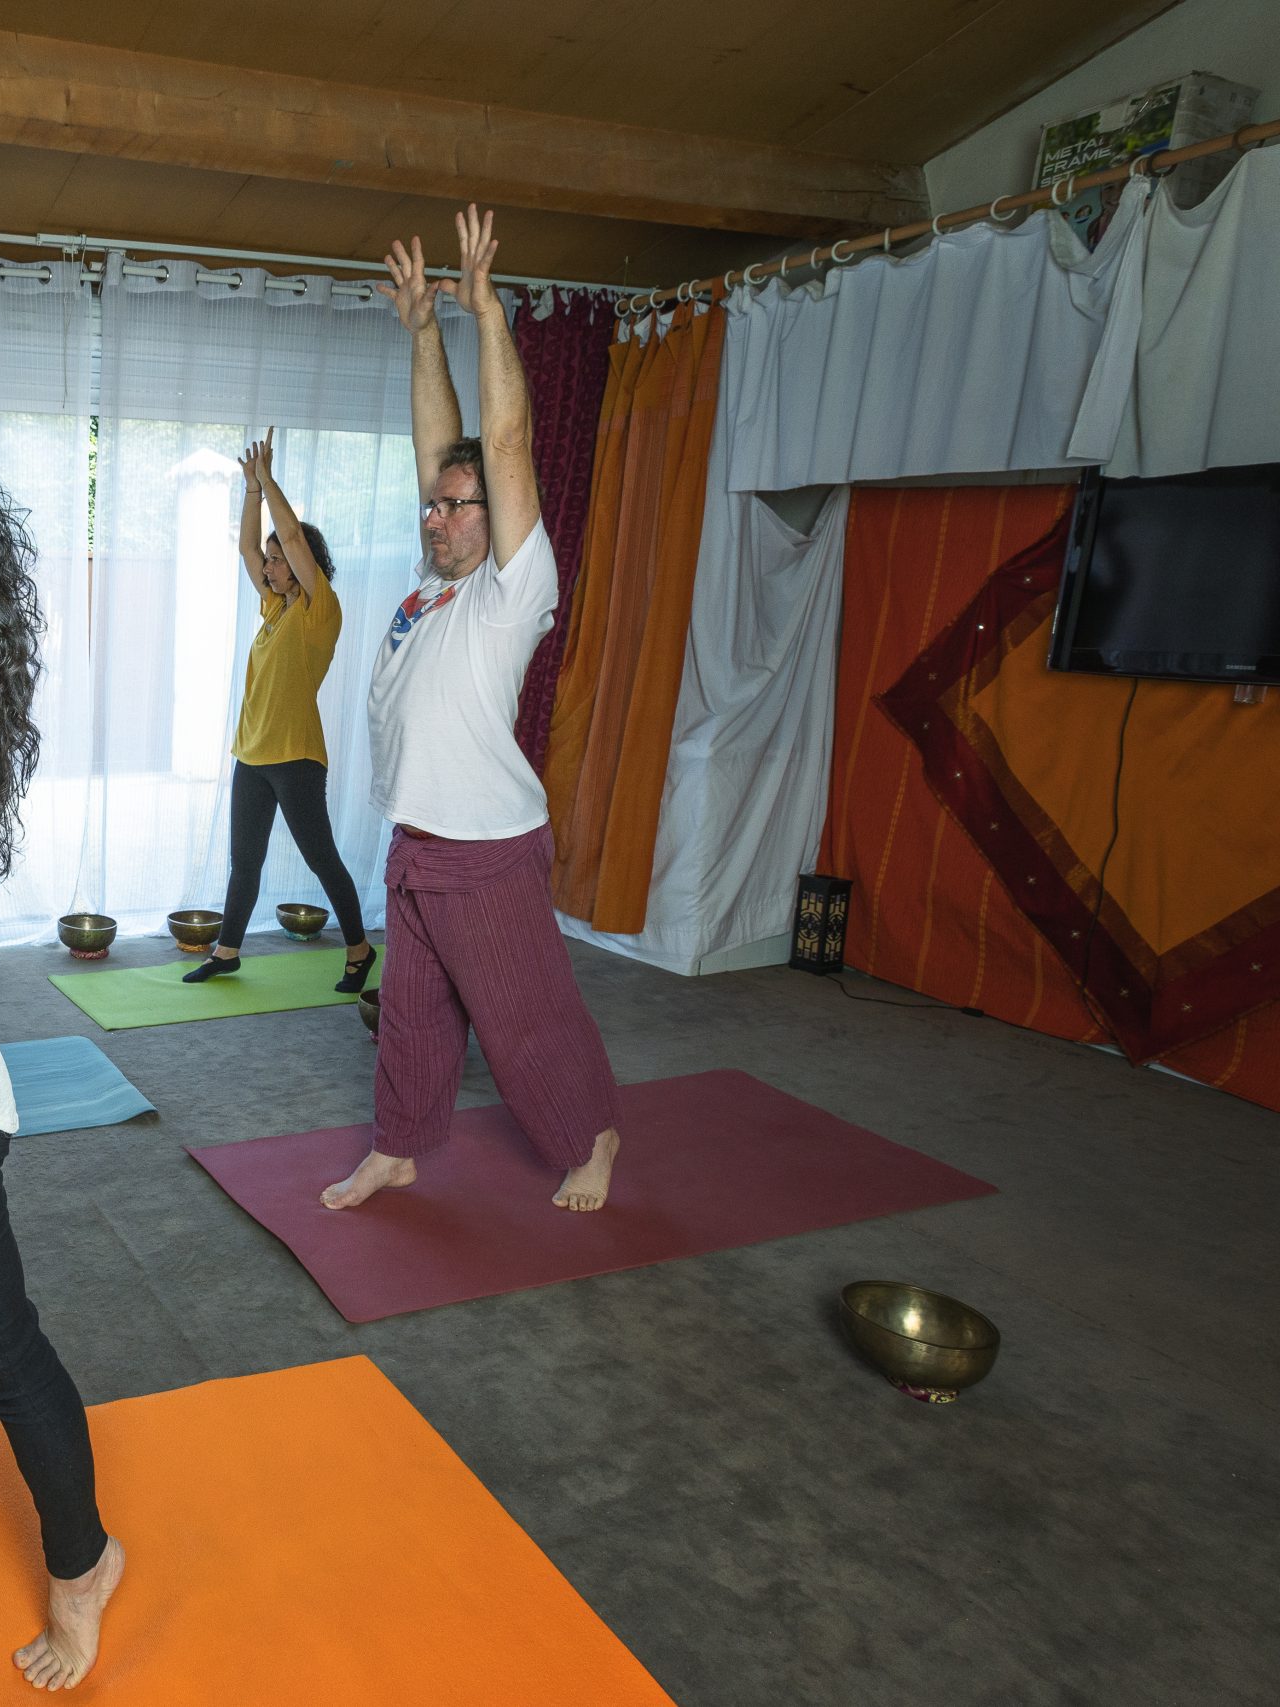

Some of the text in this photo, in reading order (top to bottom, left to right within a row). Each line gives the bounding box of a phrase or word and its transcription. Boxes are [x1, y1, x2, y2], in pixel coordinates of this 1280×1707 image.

[1042, 146, 1112, 176] FRAME
[1045, 138, 1104, 163] METAL
[1040, 169, 1080, 188] SET
